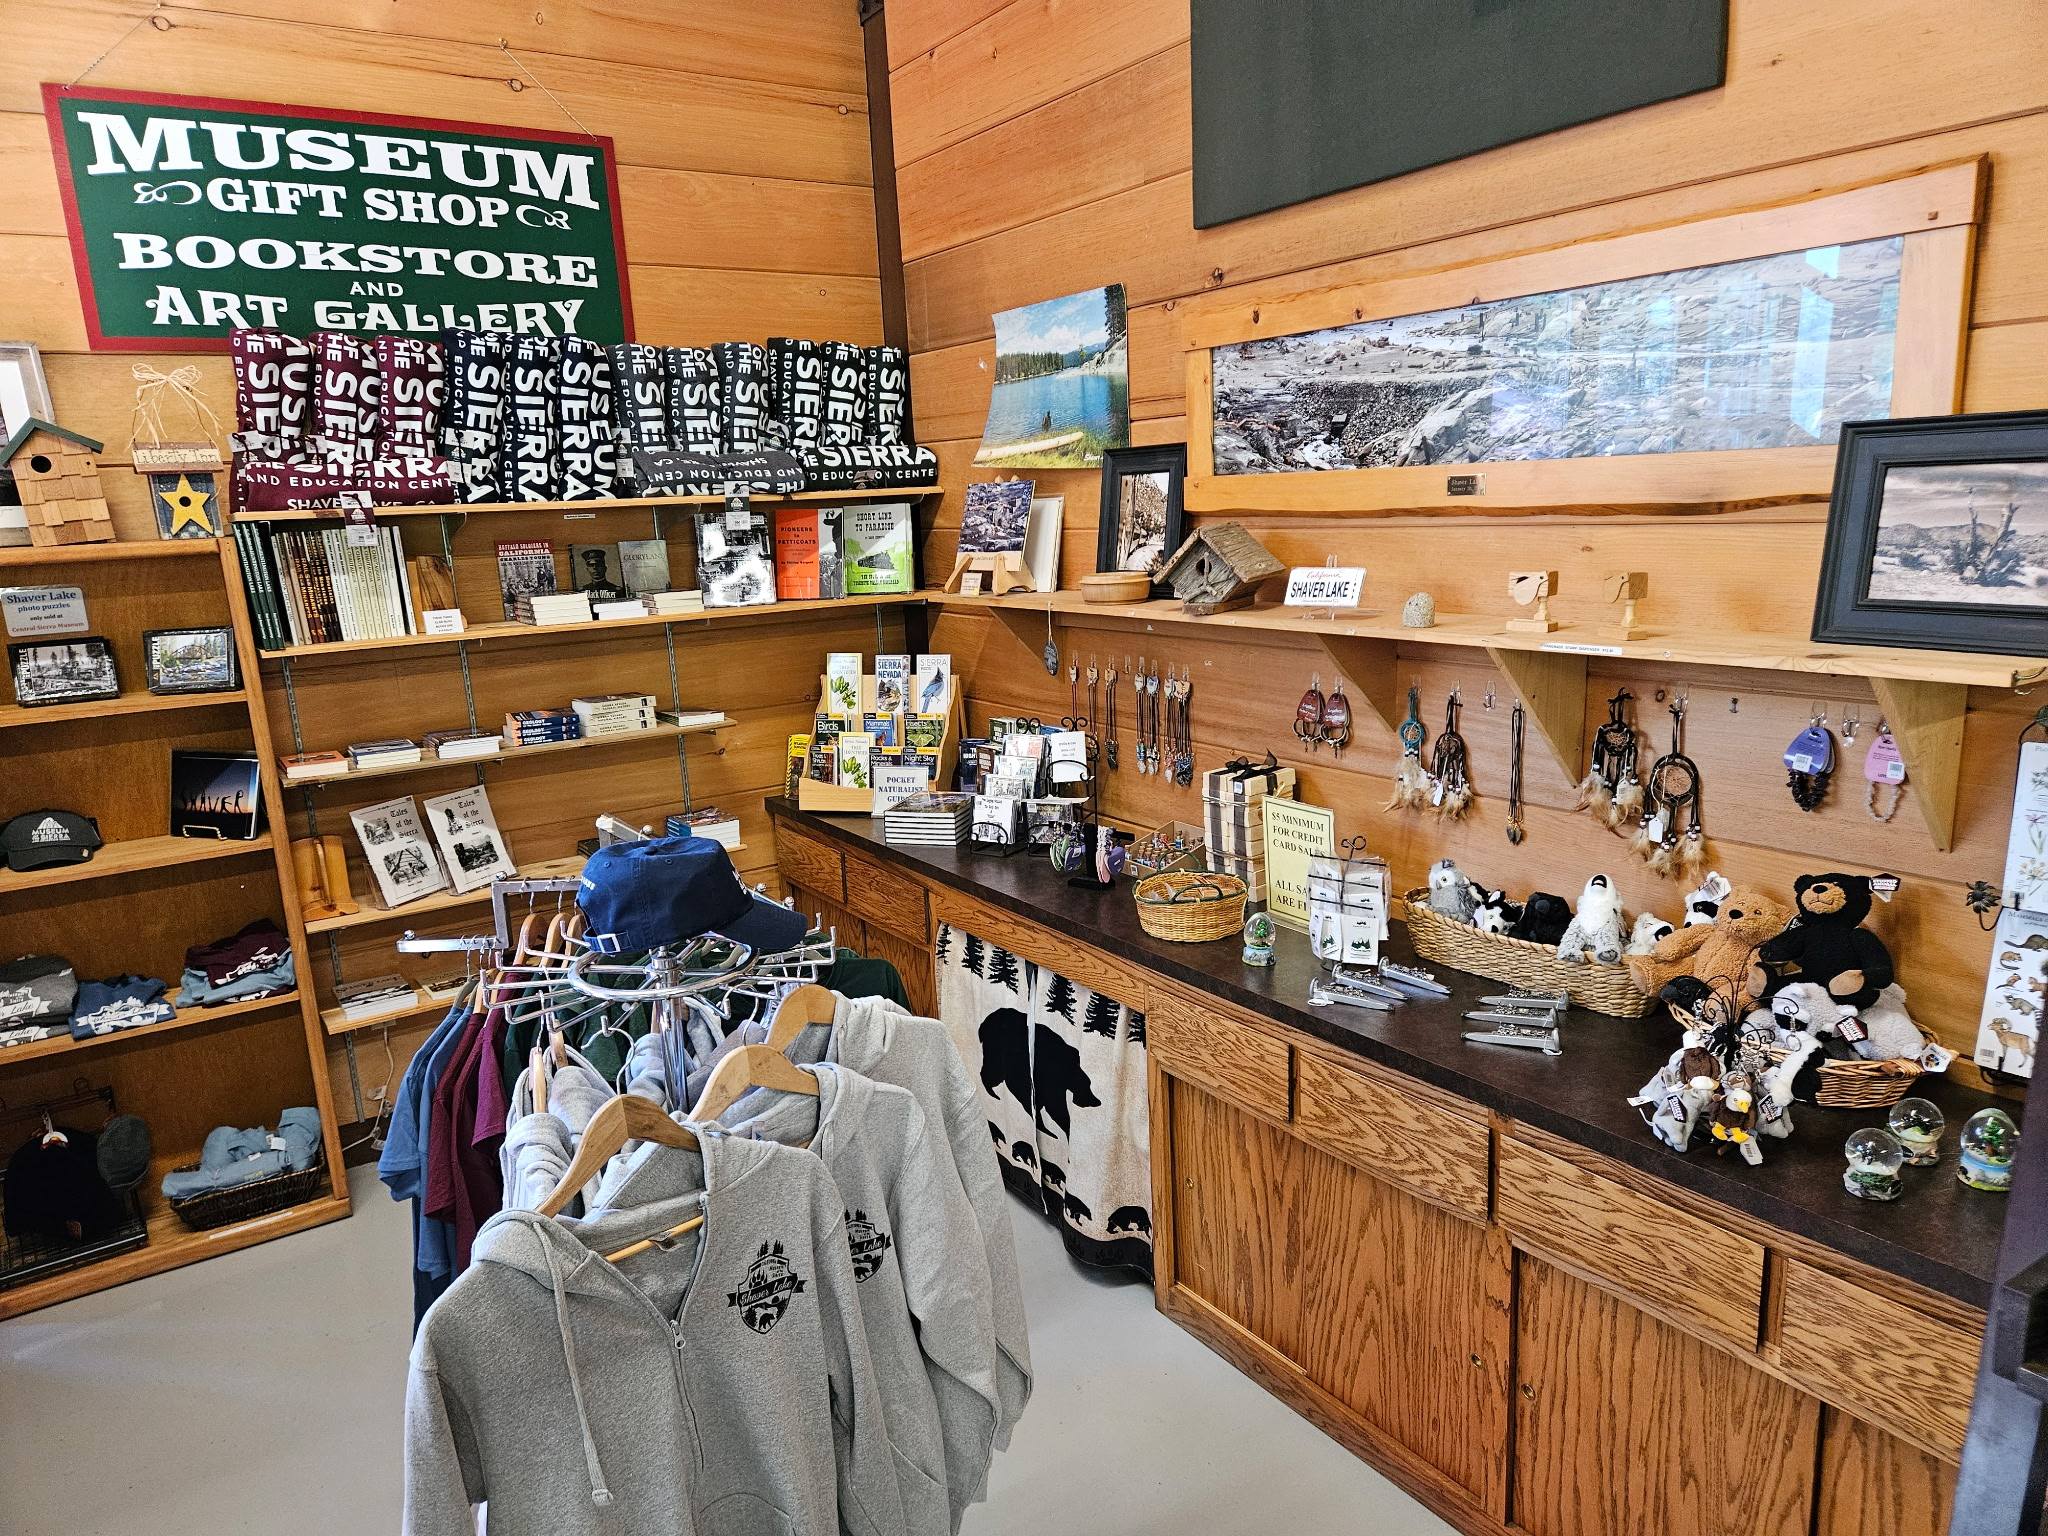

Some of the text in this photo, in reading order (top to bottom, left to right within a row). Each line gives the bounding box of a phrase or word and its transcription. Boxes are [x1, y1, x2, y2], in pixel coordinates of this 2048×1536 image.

[76, 111, 600, 210] MUSEUM
[206, 178, 509, 230] GIFT SHOP
[113, 232, 598, 289] BOOKSTORE
[350, 281, 404, 298] AND
[146, 285, 585, 338] ART GALLERY
[409, 340, 425, 365] OF
[643, 345, 658, 371] OF
[693, 349, 708, 373] OF
[738, 343, 752, 375] THE
[752, 346, 762, 372] OF
[560, 358, 593, 502] SIERRA
[818, 446, 937, 467] SIERRA
[856, 511, 876, 522] SHORT
[855, 523, 863, 532] TO
[498, 548, 551, 557] CALIFORNIA
[7, 590, 77, 604] Shaver Lake
[1290, 581, 1350, 598] SHAVER LAKE
[18, 602, 71, 613] photo puzzles
[150, 636, 161, 664] PUZZLE
[878, 660, 902, 670] SIERRA
[920, 658, 947, 667] SIERRA
[878, 670, 902, 679] NEVADA
[817, 721, 839, 731] Birds
[458, 799, 476, 809] Tales
[390, 808, 409, 818] Tales
[1271, 812, 1325, 832] $5 MINIMUM
[31, 828, 70, 836] MUSEUM
[1272, 825, 1325, 846] FOR CREDIT
[1272, 838, 1297, 853] CARD
[1275, 880, 1295, 893] ALL
[1275, 894, 1295, 908] ARE
[863, 1238, 884, 1252] Lake
[741, 1276, 793, 1305] Shaver Lake
